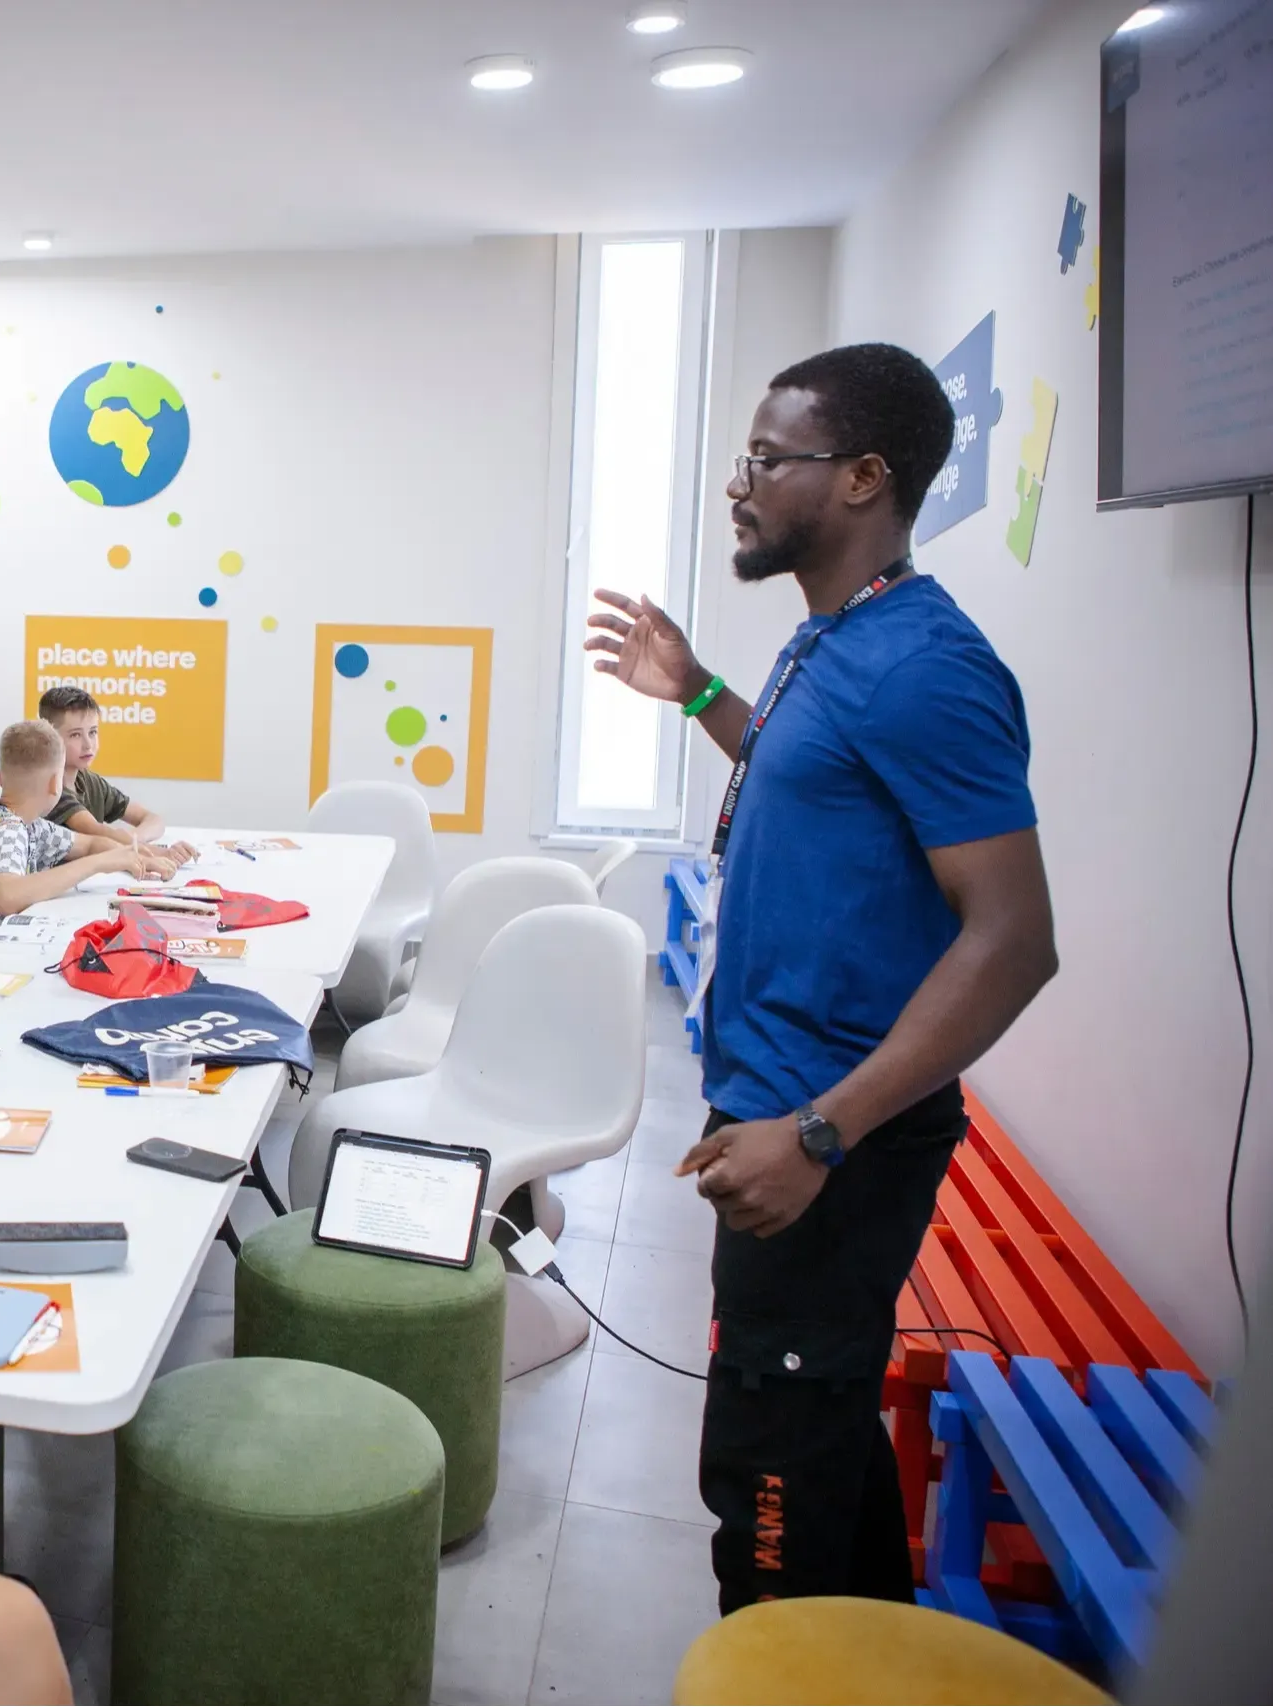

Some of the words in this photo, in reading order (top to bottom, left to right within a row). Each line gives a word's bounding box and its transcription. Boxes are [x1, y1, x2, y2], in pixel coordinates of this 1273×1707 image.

[37, 643, 108, 670] place
[112, 645, 196, 669] where
[37, 672, 167, 697] memories
[761, 687, 780, 718] ENJOY
[777, 659, 795, 688] CAMP
[722, 786, 739, 816] ENJOY
[731, 760, 748, 789] CAMP
